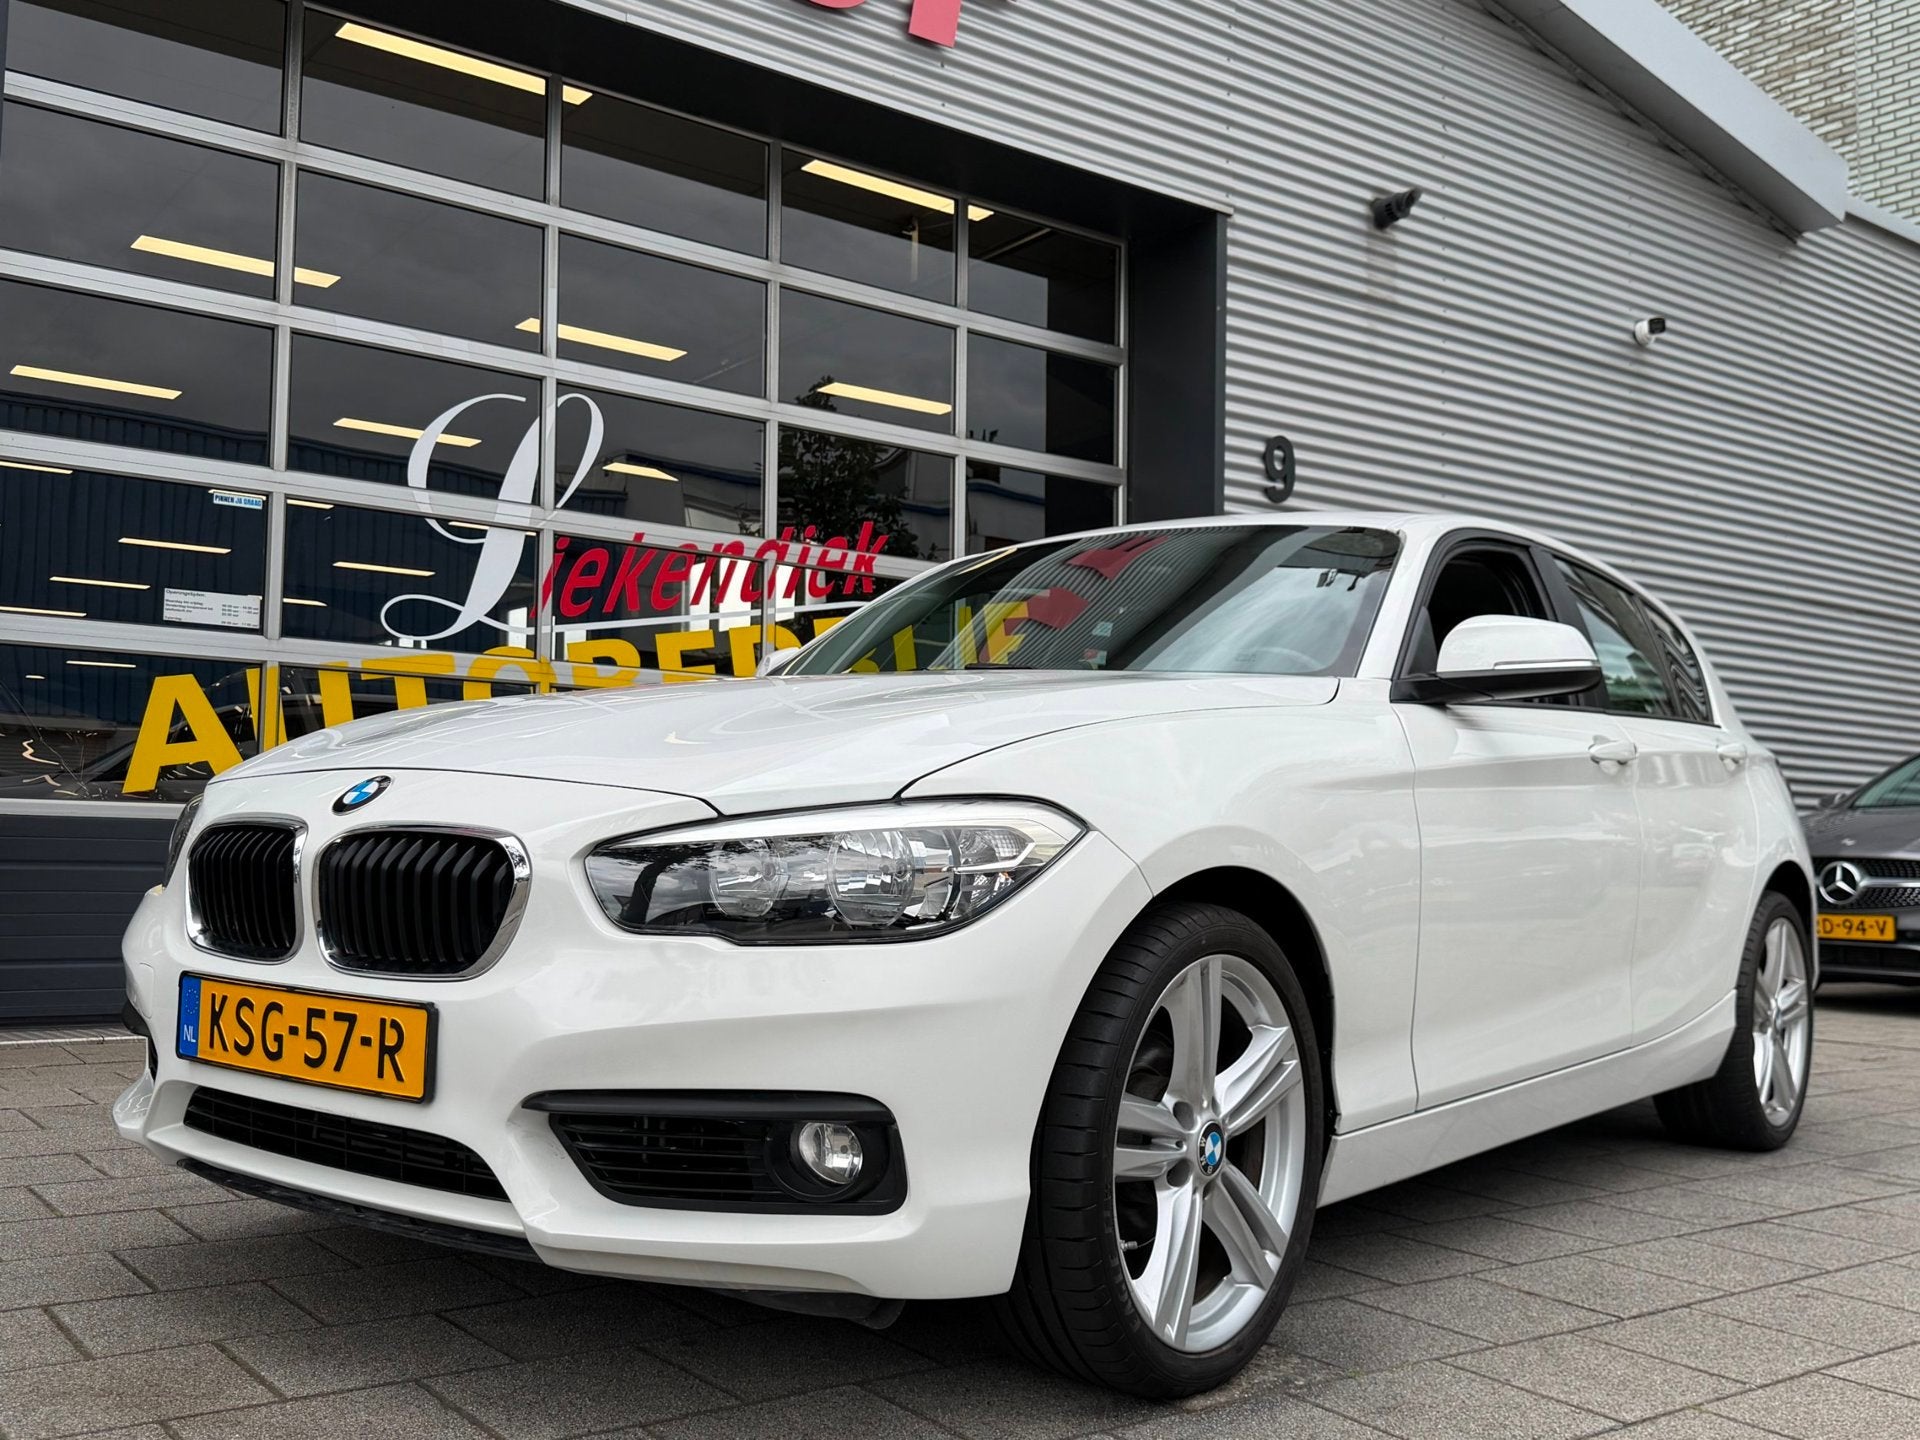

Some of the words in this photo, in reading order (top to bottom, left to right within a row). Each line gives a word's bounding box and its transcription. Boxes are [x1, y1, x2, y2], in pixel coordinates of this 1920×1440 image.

[1262, 436, 1295, 504] 9
[380, 393, 889, 642] Liekendiek
[183, 1024, 196, 1043] NL
[209, 992, 405, 1083] KSG-57-R
